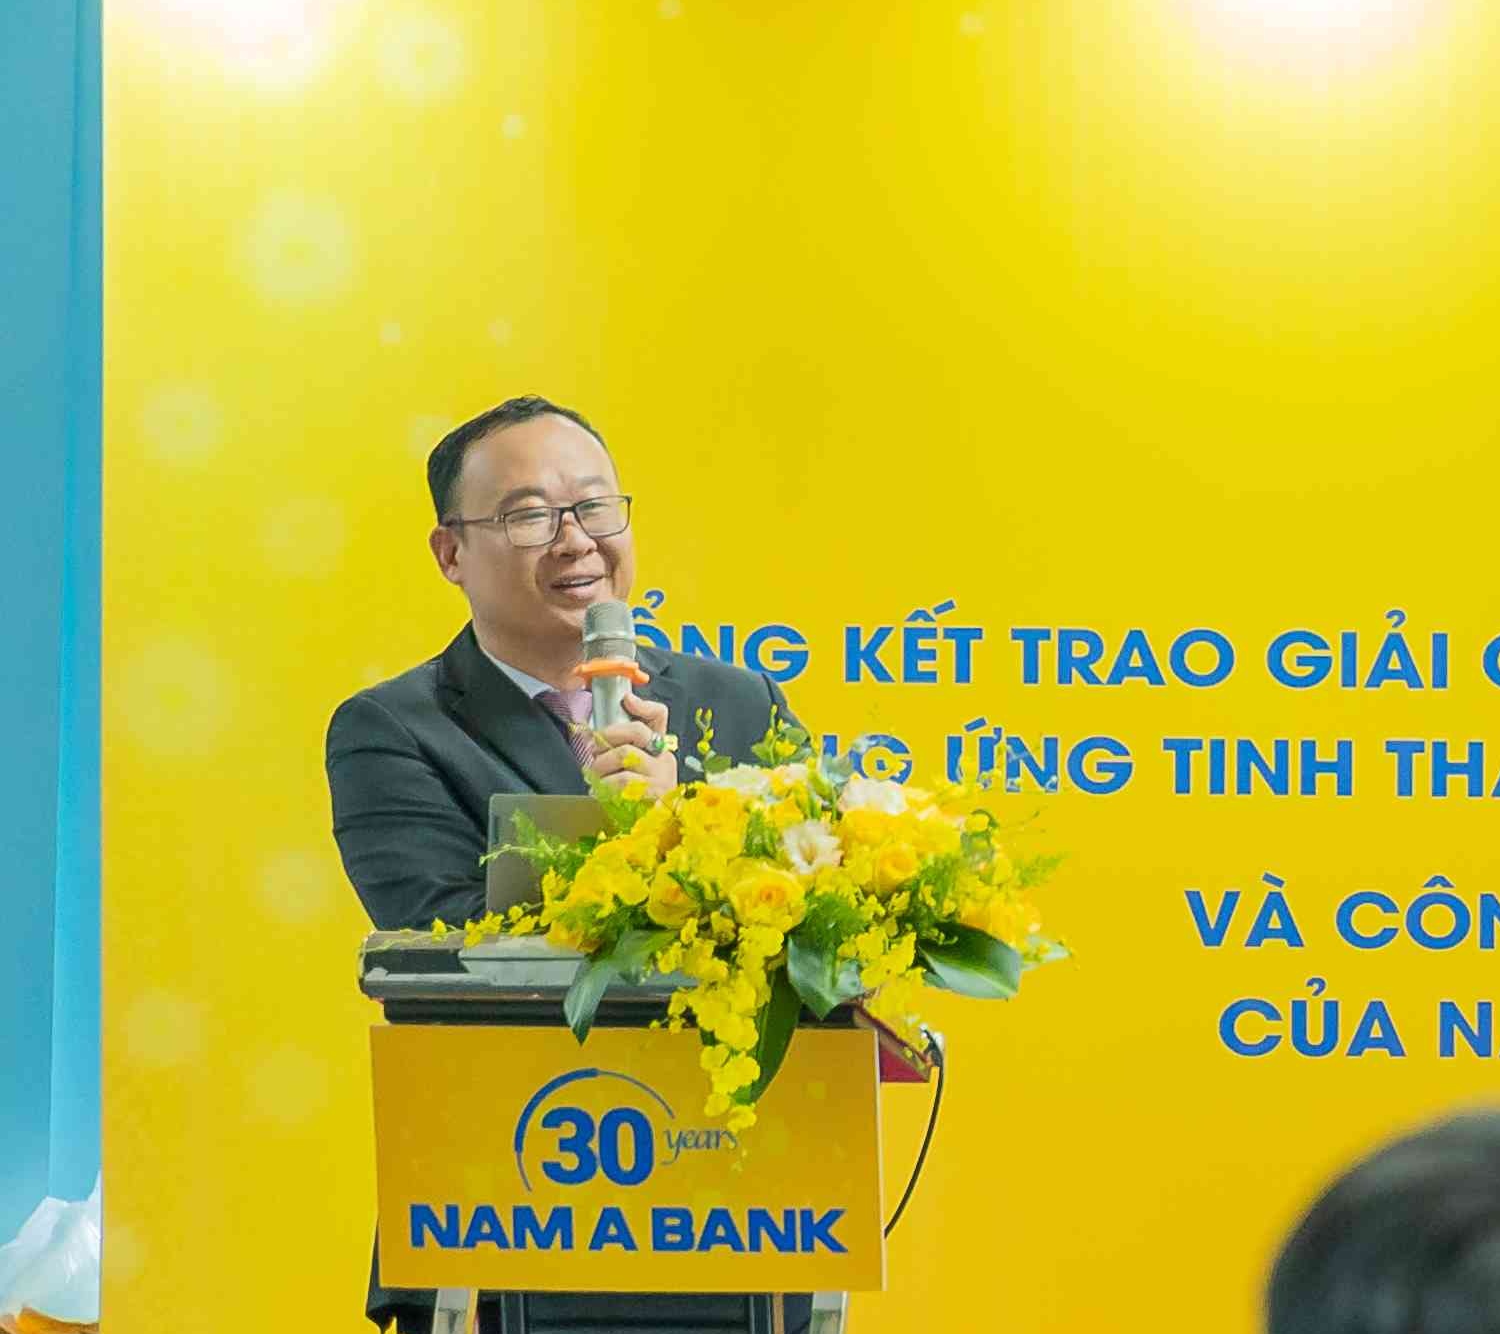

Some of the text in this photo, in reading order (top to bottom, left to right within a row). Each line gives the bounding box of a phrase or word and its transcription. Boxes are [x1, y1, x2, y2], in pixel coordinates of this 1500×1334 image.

[844, 599, 984, 685] KẾT
[1010, 628, 1236, 689] TRAO
[1266, 609, 1449, 690] GIẢI
[1162, 738, 1354, 797] TINH
[1185, 872, 1304, 949] VÀ
[1218, 977, 1405, 1058] CỦA
[541, 1106, 654, 1186] 30
[659, 1127, 739, 1167] years
[410, 1204, 848, 1253] NAM A BANK
